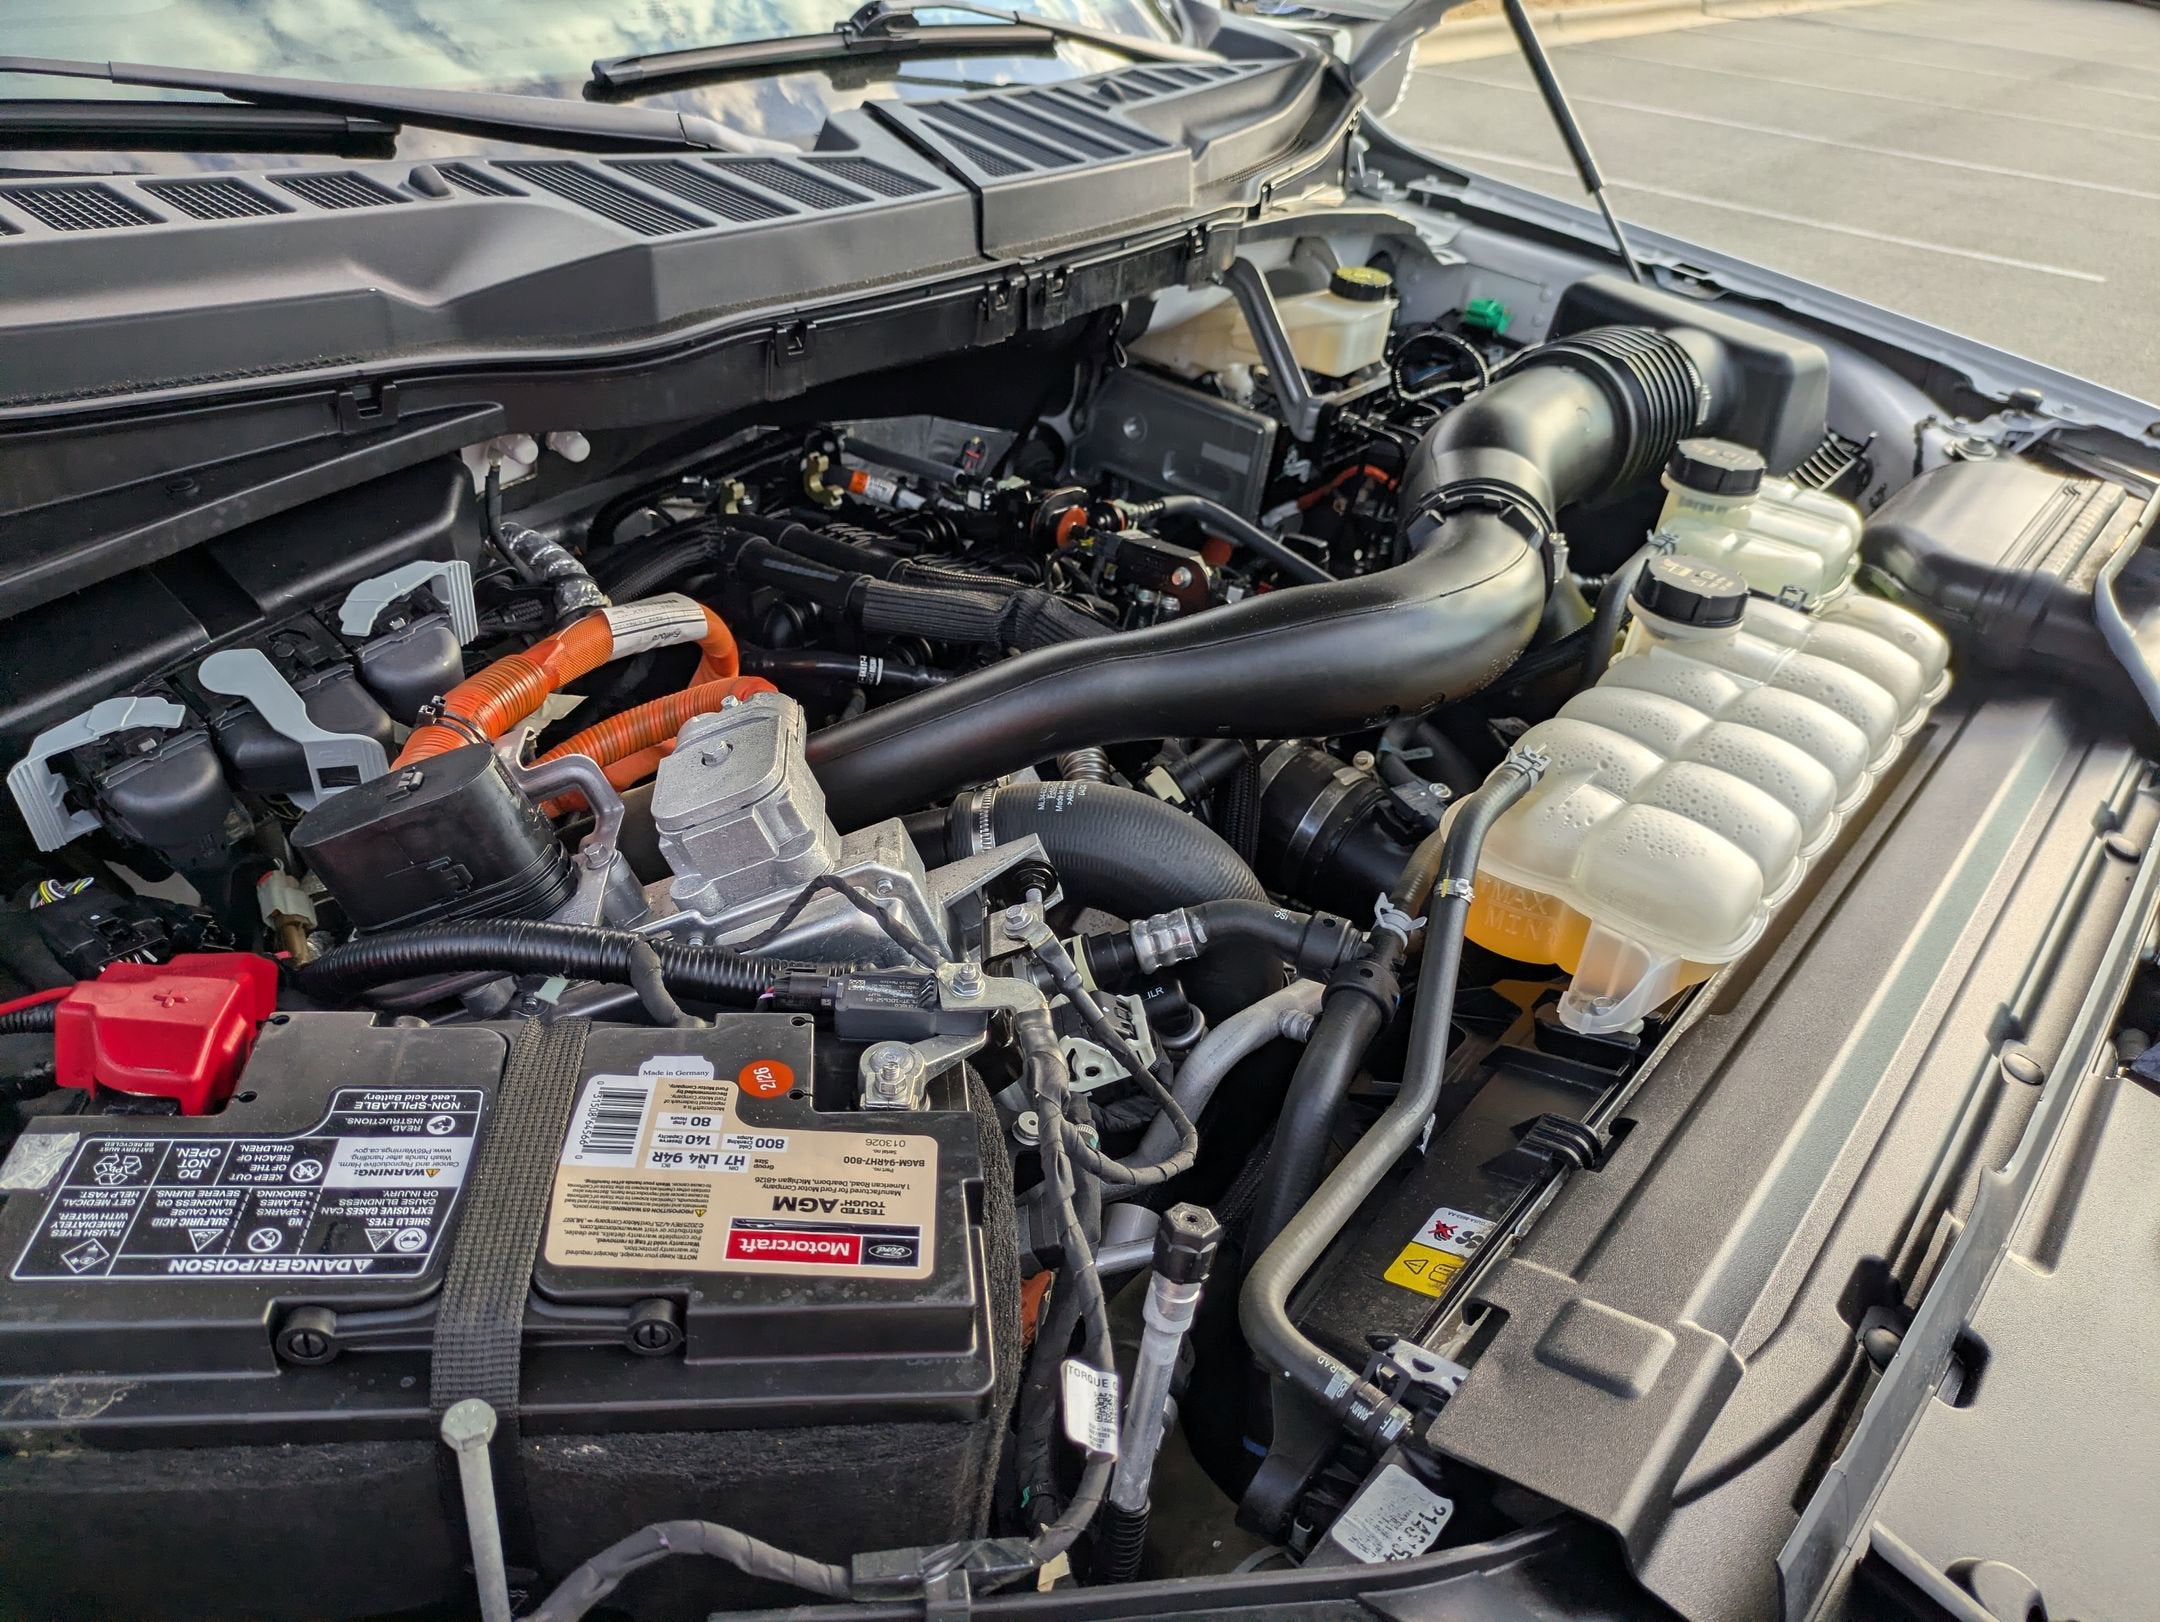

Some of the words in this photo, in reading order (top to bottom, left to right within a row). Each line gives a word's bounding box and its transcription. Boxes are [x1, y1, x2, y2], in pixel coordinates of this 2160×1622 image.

[1490, 880, 1551, 916] MAX
[1484, 904, 1543, 941] MIN
[752, 1066, 776, 1091] 2/26
[364, 1092, 402, 1101] Battery
[354, 1101, 460, 1110] NON-SPILLABLE
[690, 1116, 712, 1127] 80
[685, 1134, 711, 1146] 140
[755, 1138, 785, 1149] 800
[865, 1138, 906, 1148] 013026
[239, 1144, 294, 1152] CHILDREN.
[176, 1148, 222, 1158] OPEN.
[652, 1151, 683, 1163] 94R
[236, 1154, 253, 1162] OF
[254, 1154, 291, 1162] REACH
[689, 1153, 718, 1164] LN4
[724, 1155, 745, 1166] H7
[843, 1156, 925, 1167] BAGM-94RH7-800
[177, 1158, 211, 1168] NOT
[363, 1160, 414, 1168] Reproductive
[109, 1165, 123, 1173] Pb
[354, 1168, 425, 1176] WARNING:
[178, 1169, 202, 1179] DO
[228, 1173, 252, 1181] OUT
[778, 1177, 811, 1186] Michigan
[812, 1178, 848, 1187] Dearborn,
[850, 1180, 870, 1188] Road,
[762, 1182, 796, 1191] Company
[110, 1190, 140, 1198] HELP
[850, 1187, 901, 1196] Manufactured
[62, 1198, 111, 1206] MEDICAL
[112, 1198, 136, 1206] GET
[339, 1198, 399, 1206] BLINDNESS
[772, 1196, 839, 1214] AGM
[170, 1208, 208, 1216] CAUSE
[346, 1207, 378, 1215] GASES
[380, 1206, 434, 1215] EXPLOSIVE
[840, 1207, 885, 1216] TESTED
[100, 1212, 128, 1220] WITH
[151, 1218, 178, 1226] ACID
[179, 1217, 229, 1226] SULFURIC
[288, 1218, 303, 1226] NO
[366, 1218, 393, 1226] EYES.
[396, 1217, 431, 1226] SHIELD
[51, 1229, 82, 1237] EYES
[83, 1229, 122, 1237] FLUSH
[740, 1238, 850, 1256] Motorcraft
[876, 1246, 906, 1257] Ford
[168, 1259, 352, 1272] DANGER/POISON
[1317, 1356, 1339, 1374] RAD
[1068, 1365, 1109, 1388] TORQUE
